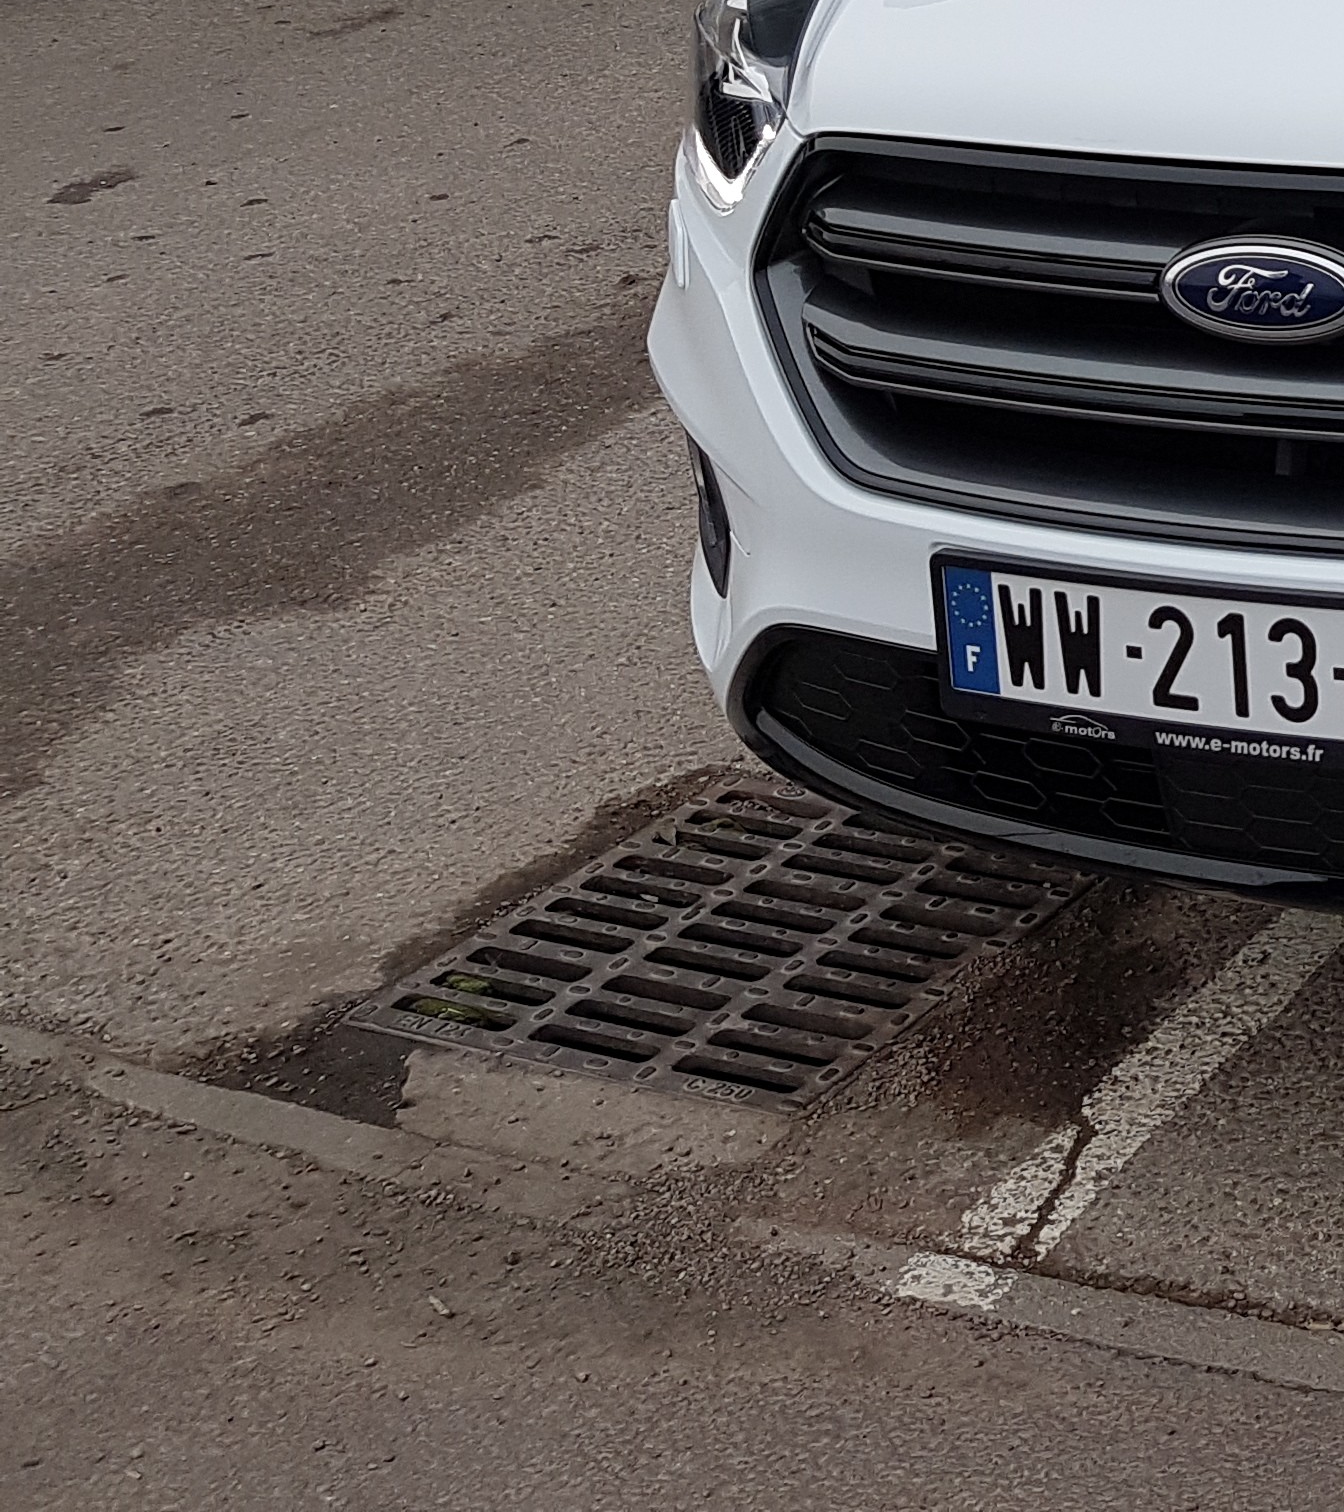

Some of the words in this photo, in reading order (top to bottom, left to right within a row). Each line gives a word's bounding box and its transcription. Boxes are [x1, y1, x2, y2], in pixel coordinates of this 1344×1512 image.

[1206, 264, 1314, 318] Ford
[965, 644, 980, 672] F
[1155, 731, 1324, 763] www.e-motors.fr
